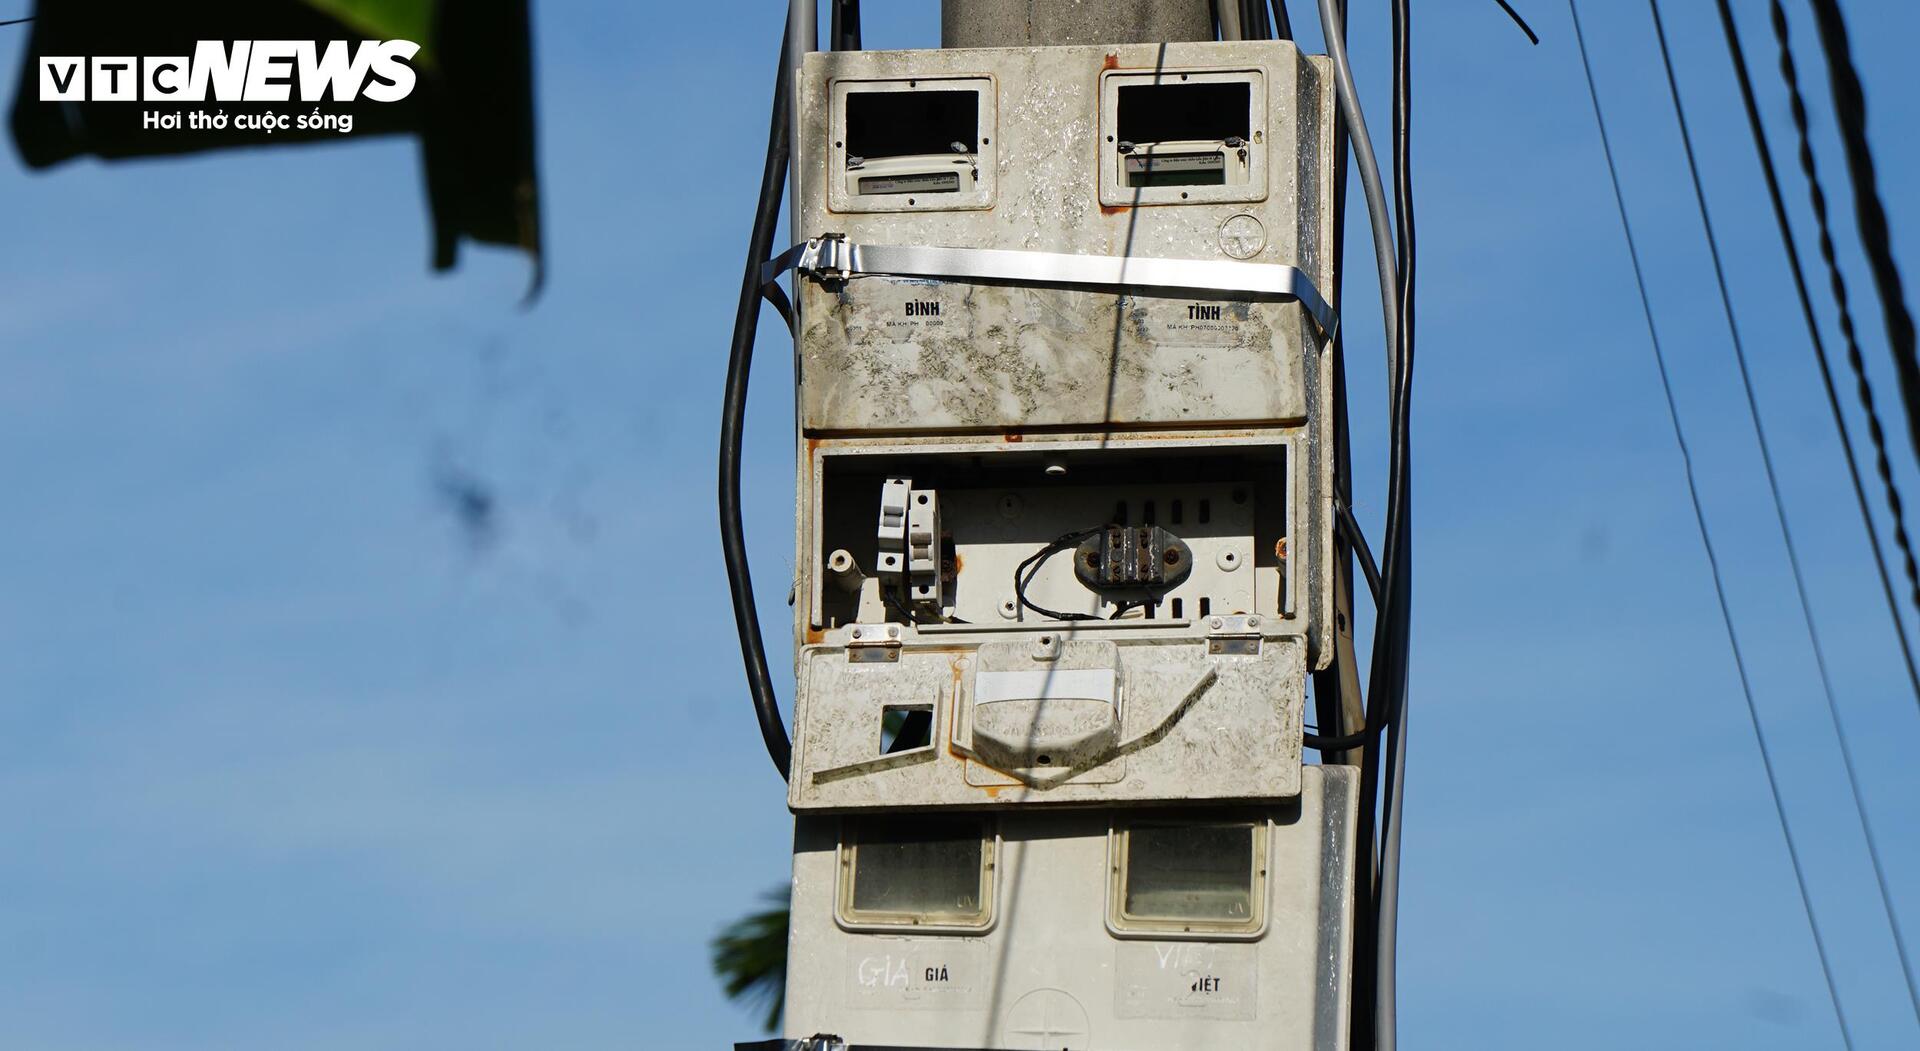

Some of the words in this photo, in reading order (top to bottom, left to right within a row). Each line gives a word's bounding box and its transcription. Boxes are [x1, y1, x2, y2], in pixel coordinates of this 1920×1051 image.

[905, 299, 940, 317] BÌNH
[1187, 302, 1221, 321] TÌNH
[925, 964, 949, 982] GIÁ
